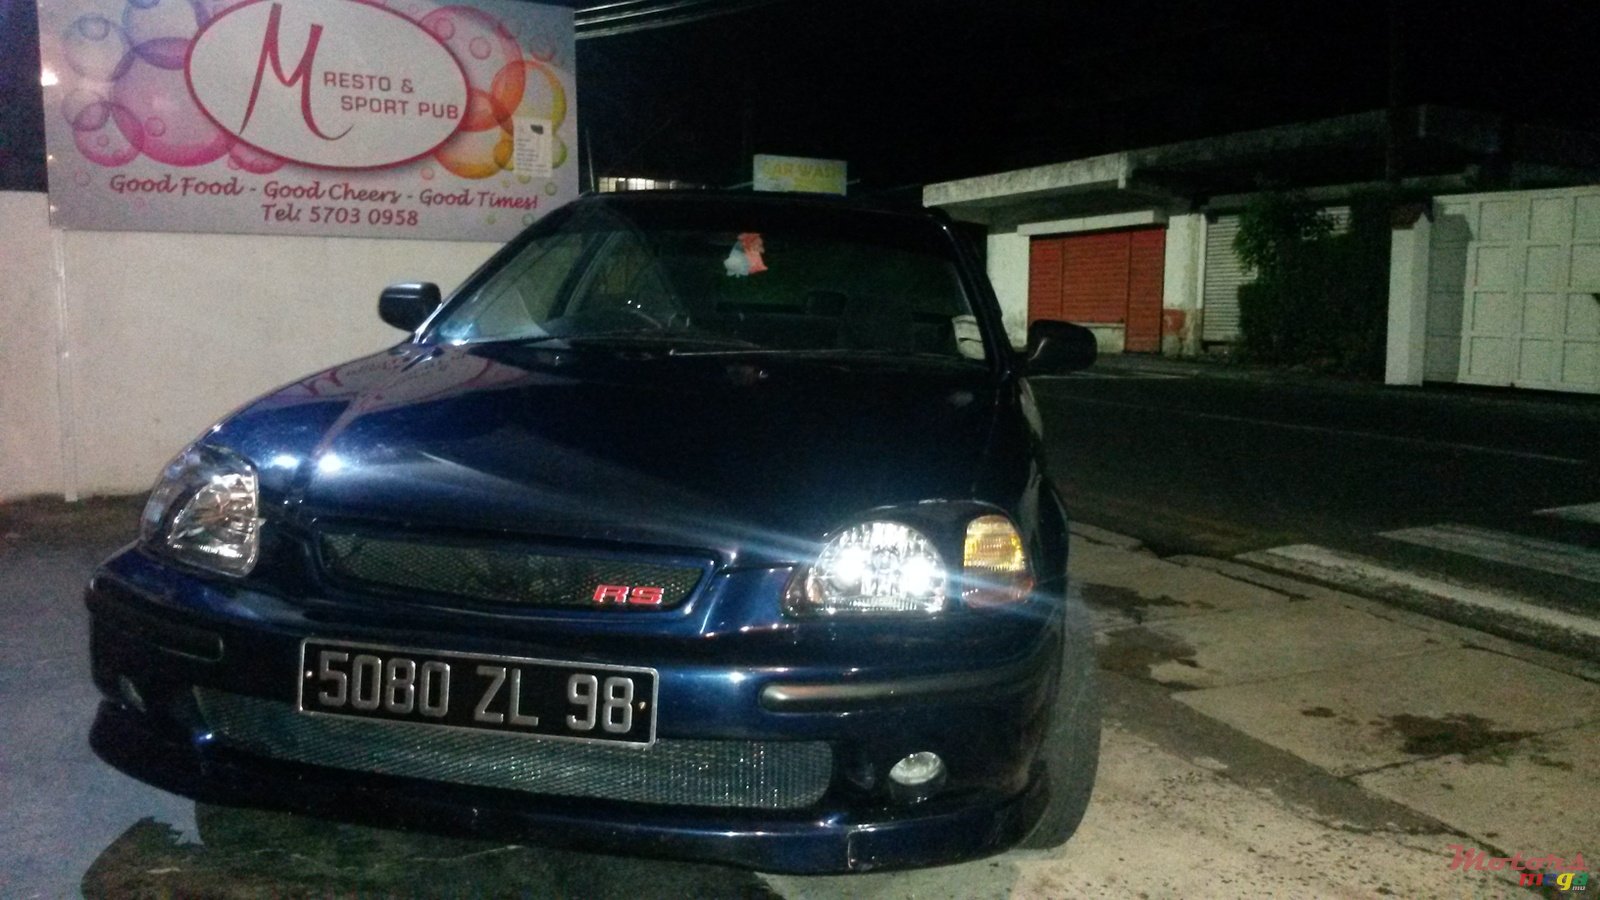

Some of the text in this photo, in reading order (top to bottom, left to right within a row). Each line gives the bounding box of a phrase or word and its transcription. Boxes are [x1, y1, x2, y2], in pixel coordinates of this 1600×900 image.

[323, 71, 415, 93] RESTO &
[340, 95, 459, 119] SPORT PUB
[109, 174, 180, 194] Good
[181, 177, 244, 196] Food
[263, 180, 326, 199] Good
[328, 182, 401, 203] Cheers
[419, 189, 475, 206] Good
[477, 191, 538, 210] Times!
[309, 206, 361, 224] 5703
[368, 208, 419, 226] 0958
[592, 584, 665, 605] RS
[317, 651, 634, 734] 5080 ZL 98
